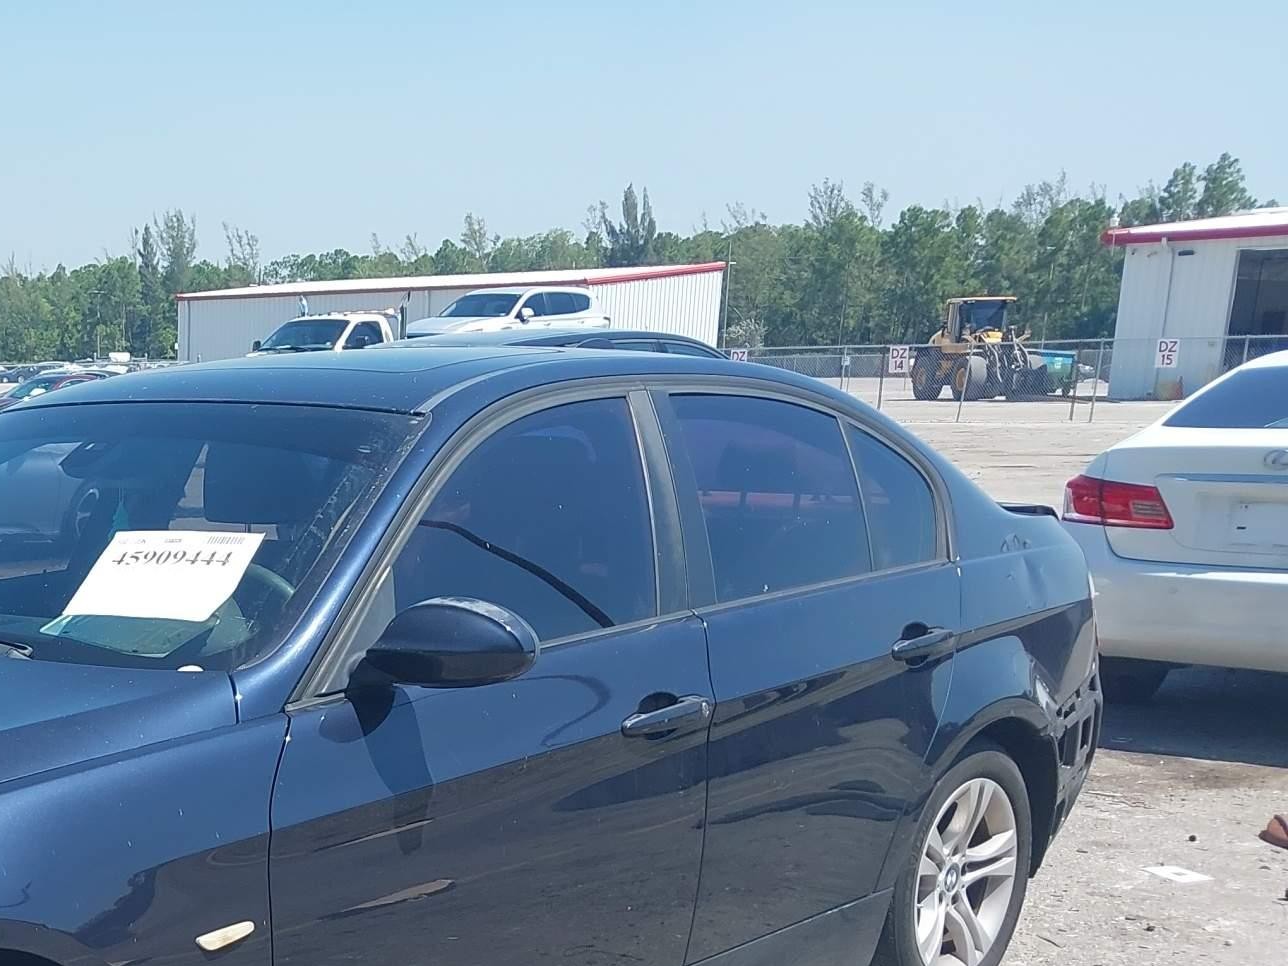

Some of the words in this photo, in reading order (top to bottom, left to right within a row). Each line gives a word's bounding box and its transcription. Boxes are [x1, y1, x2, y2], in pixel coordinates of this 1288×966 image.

[1158, 340, 1178, 353] DZ
[891, 348, 907, 359] DZ
[1161, 353, 1173, 366] 15
[894, 360, 904, 371] 14
[112, 550, 233, 566] 45909444
